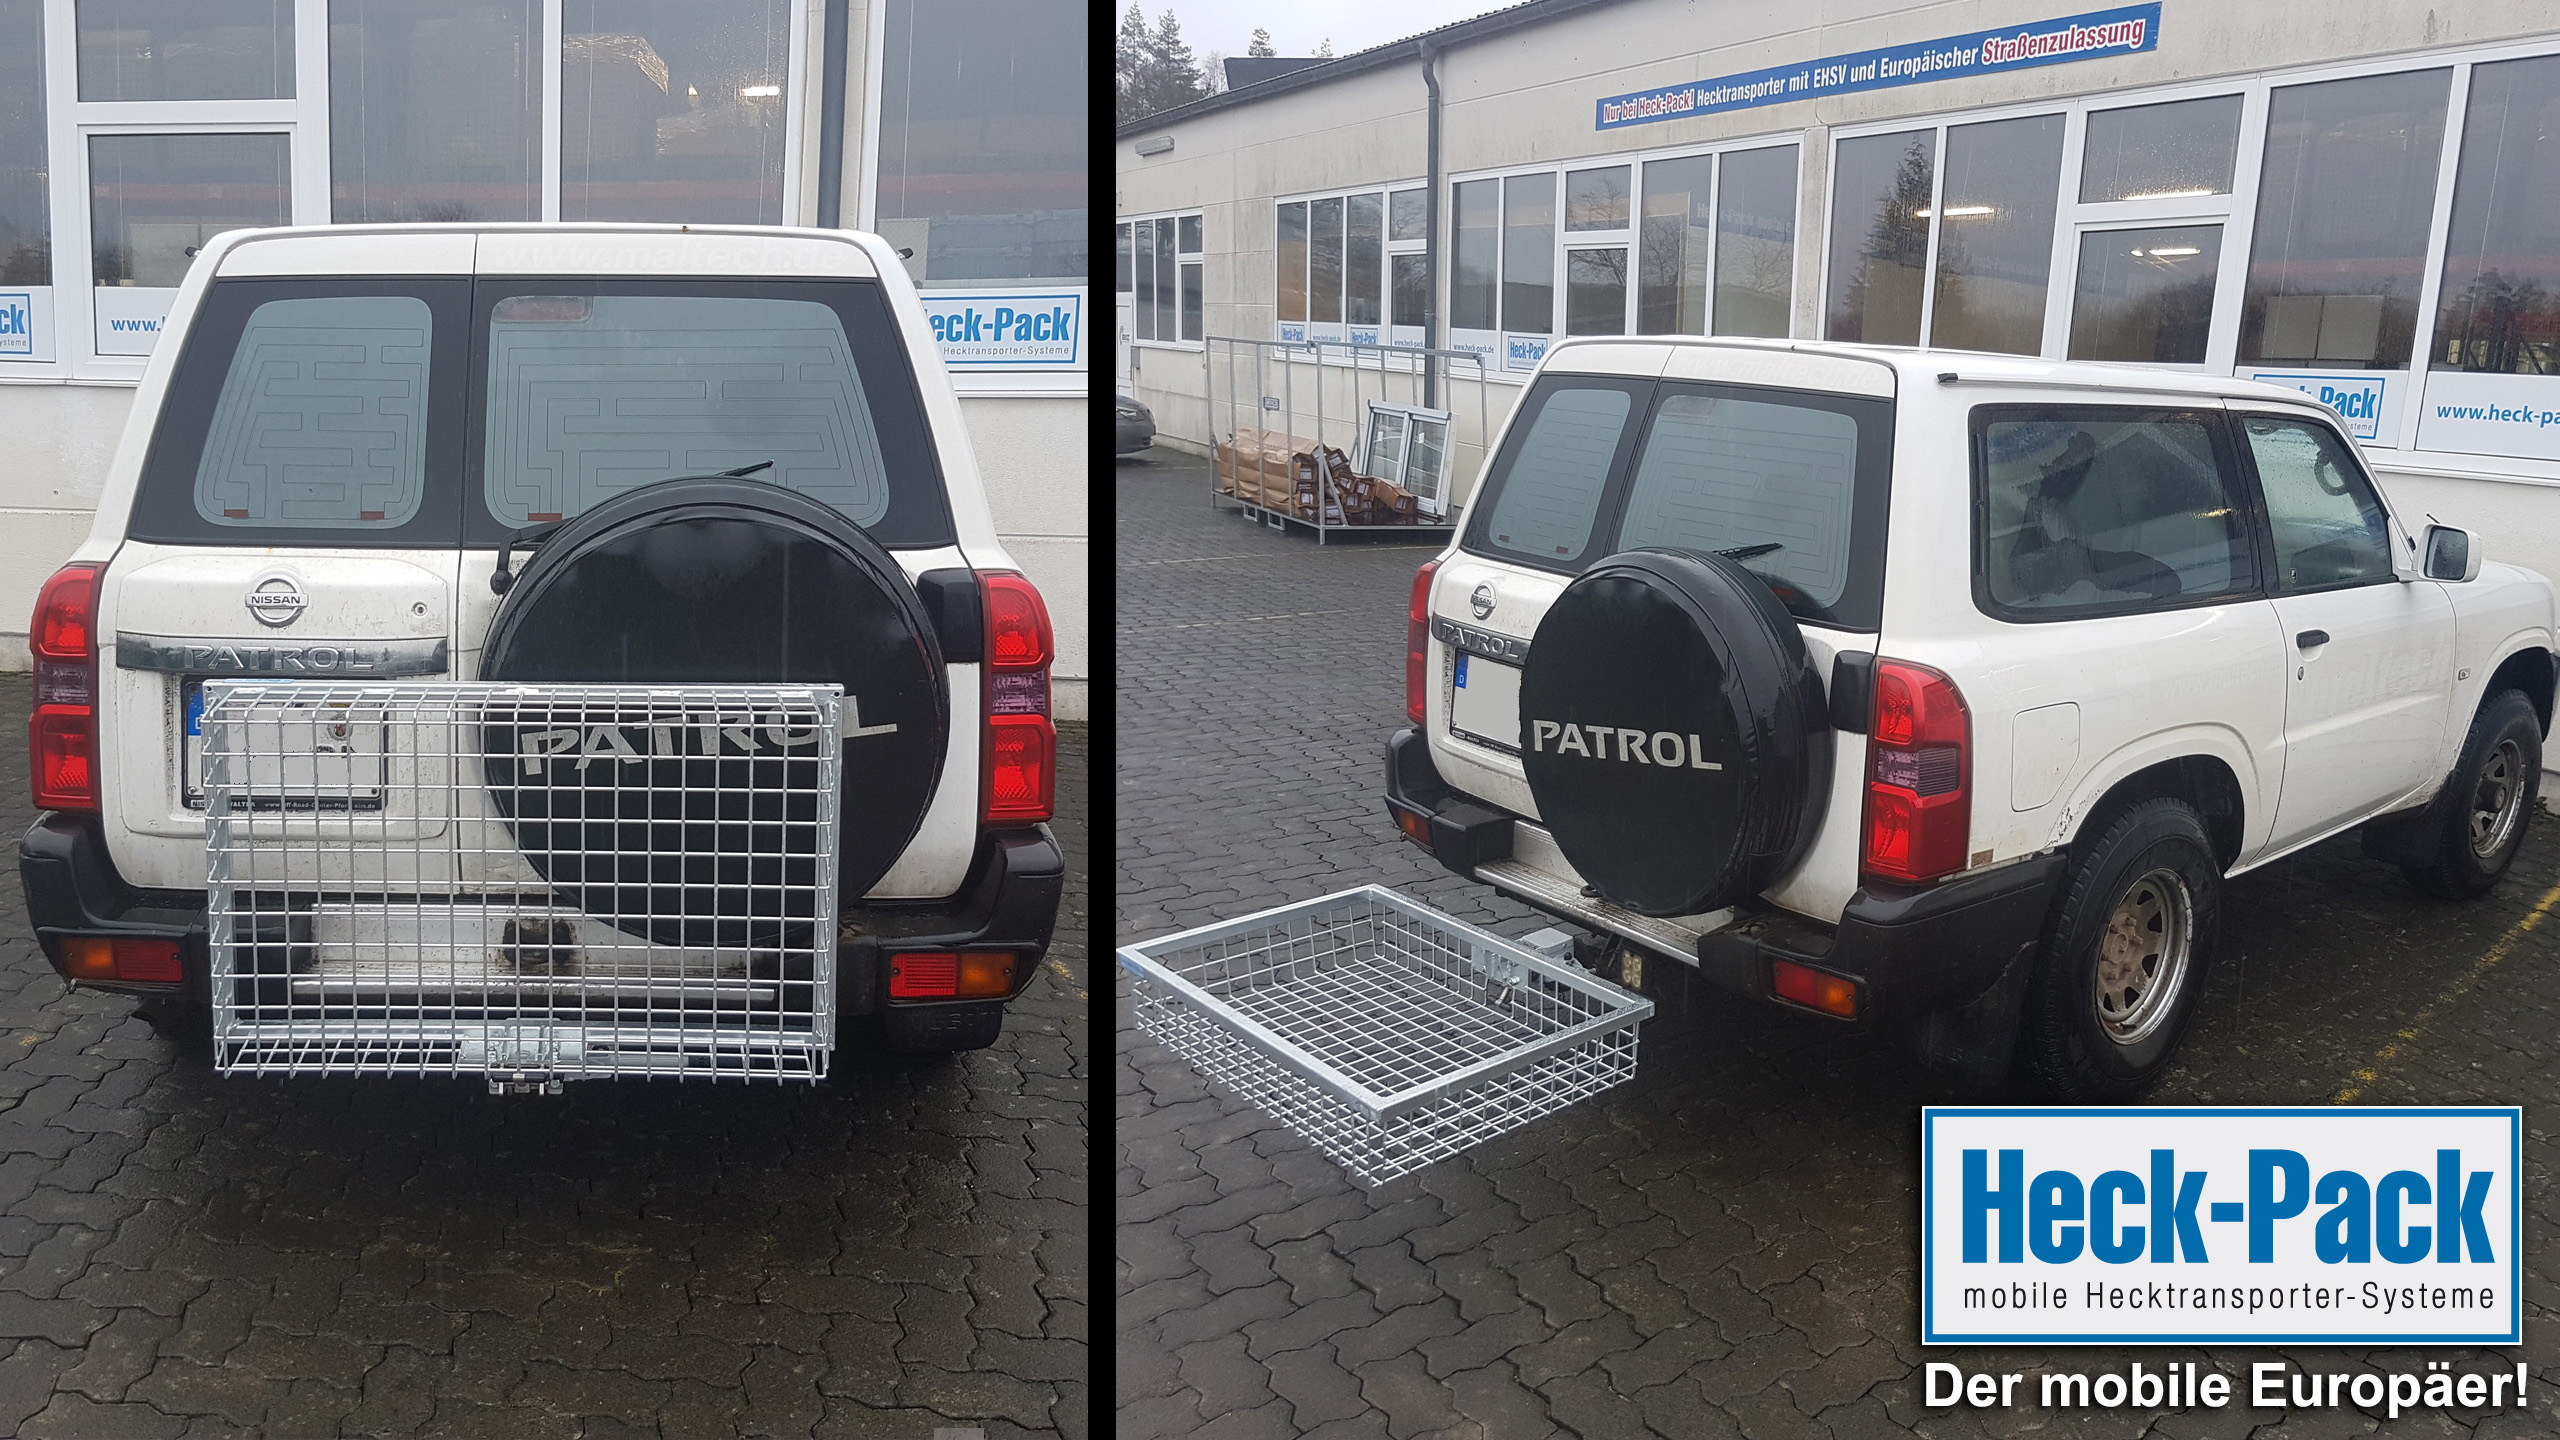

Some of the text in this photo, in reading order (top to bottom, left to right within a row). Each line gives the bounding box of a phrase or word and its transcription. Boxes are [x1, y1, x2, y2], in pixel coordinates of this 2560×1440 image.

[1604, 19, 2145, 123] Nur bei Heck-Pack! Hecktransporter mit EHSV und Europäischer Straßenzulassung
[925, 307, 1071, 342] eck-Pack
[943, 345, 1069, 357] Hecktransporter-Systeme
[1453, 343, 1494, 354] www.heck-pack.de
[1510, 341, 1546, 360] Heck-Pack
[250, 595, 301, 605] NISSAN
[1442, 622, 1519, 659] PATROL
[184, 644, 374, 671] PATROL
[521, 695, 898, 776] PATROL
[1533, 719, 1723, 771] PATROL
